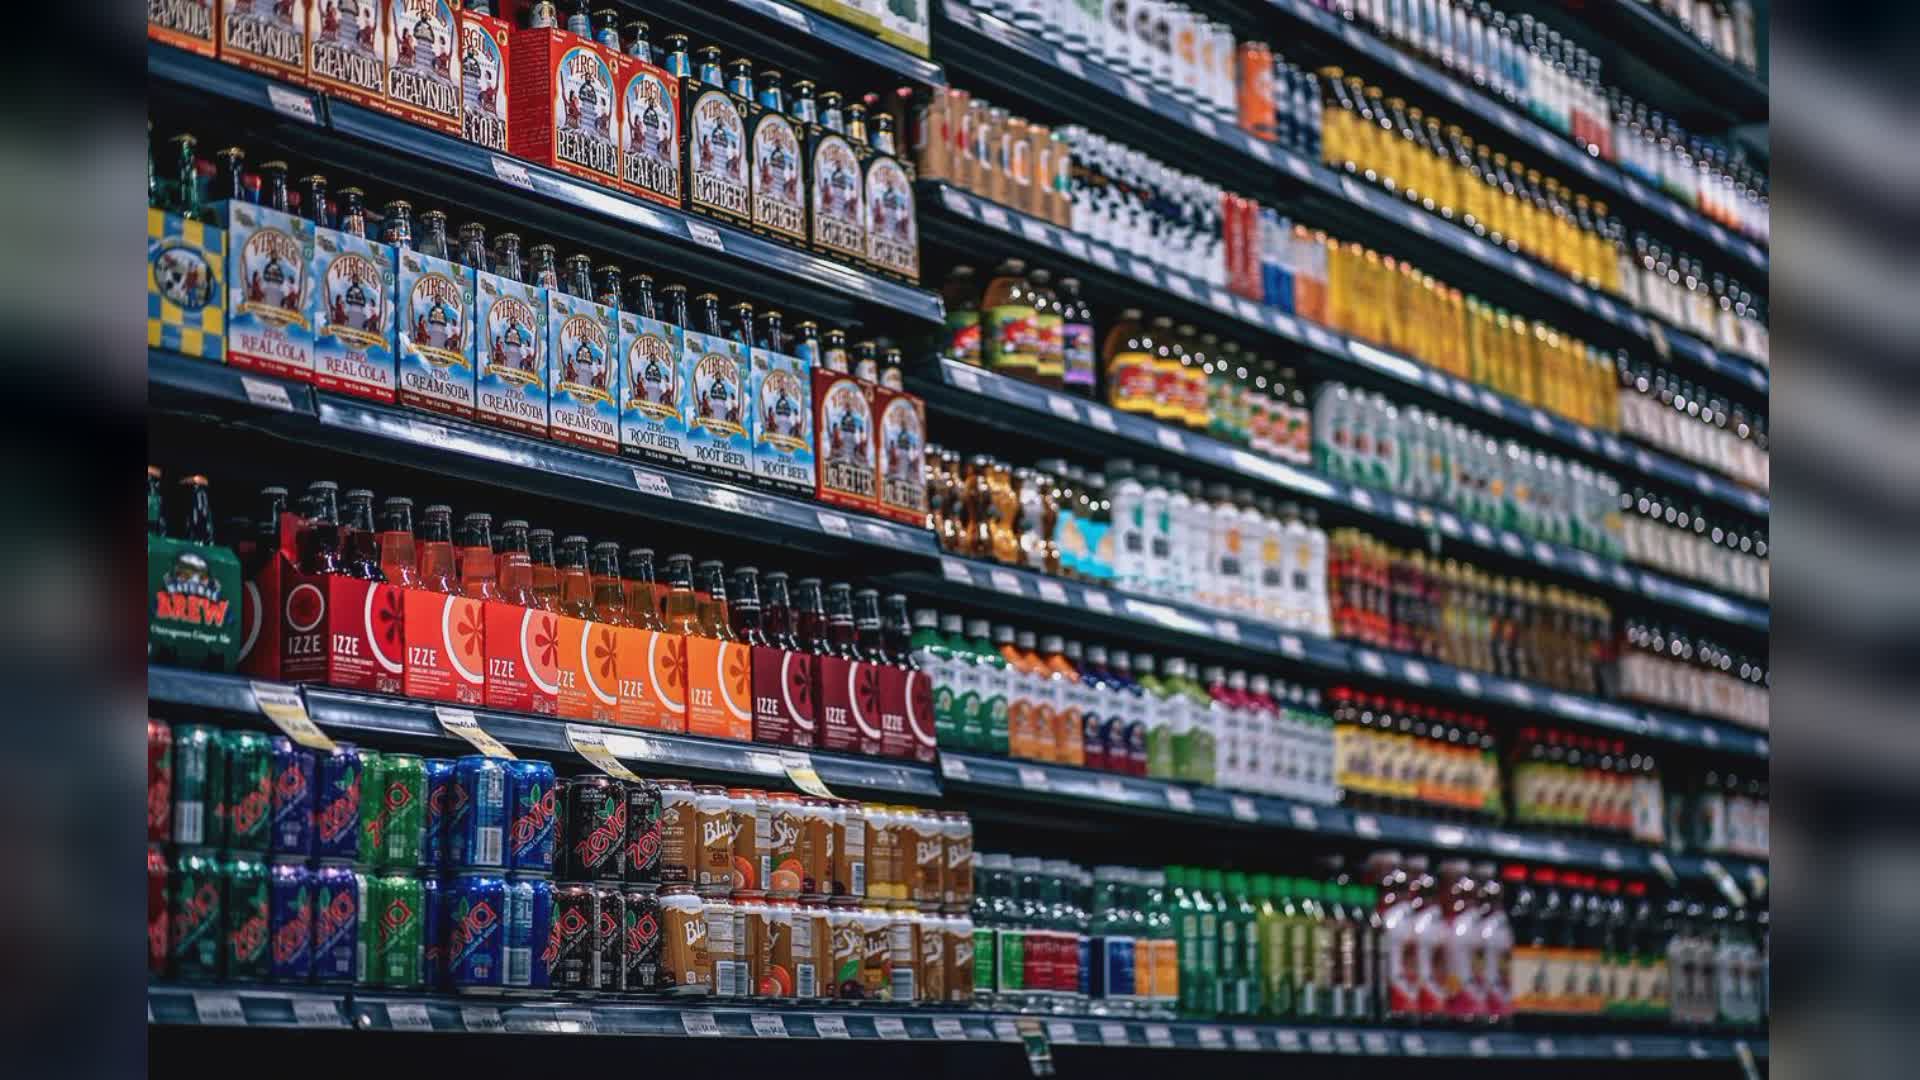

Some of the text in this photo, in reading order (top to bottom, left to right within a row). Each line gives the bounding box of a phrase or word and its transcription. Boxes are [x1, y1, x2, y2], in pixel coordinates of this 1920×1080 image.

[557, 130, 618, 176] REAL COLA
[623, 153, 651, 187] REAL
[652, 161, 678, 198] COLA
[241, 334, 307, 362] REAL COLA
[326, 356, 359, 378] REAL
[359, 364, 387, 384] COLA
[628, 427, 654, 446] ROOT
[655, 434, 680, 452] BEER
[694, 444, 720, 464] ROOT
[721, 450, 746, 470] BEER
[157, 590, 229, 627] BREW
[289, 634, 321, 655] IZZE
[333, 633, 360, 656] IZZE
[409, 646, 437, 667] IZZE
[489, 658, 515, 679] IZZE
[557, 669, 575, 689] ZZE
[618, 679, 644, 699] IZZE
[690, 687, 713, 707] IZZE
[756, 696, 779, 715] IZZE
[825, 706, 847, 725] IZZE
[882, 714, 903, 732] IZZE
